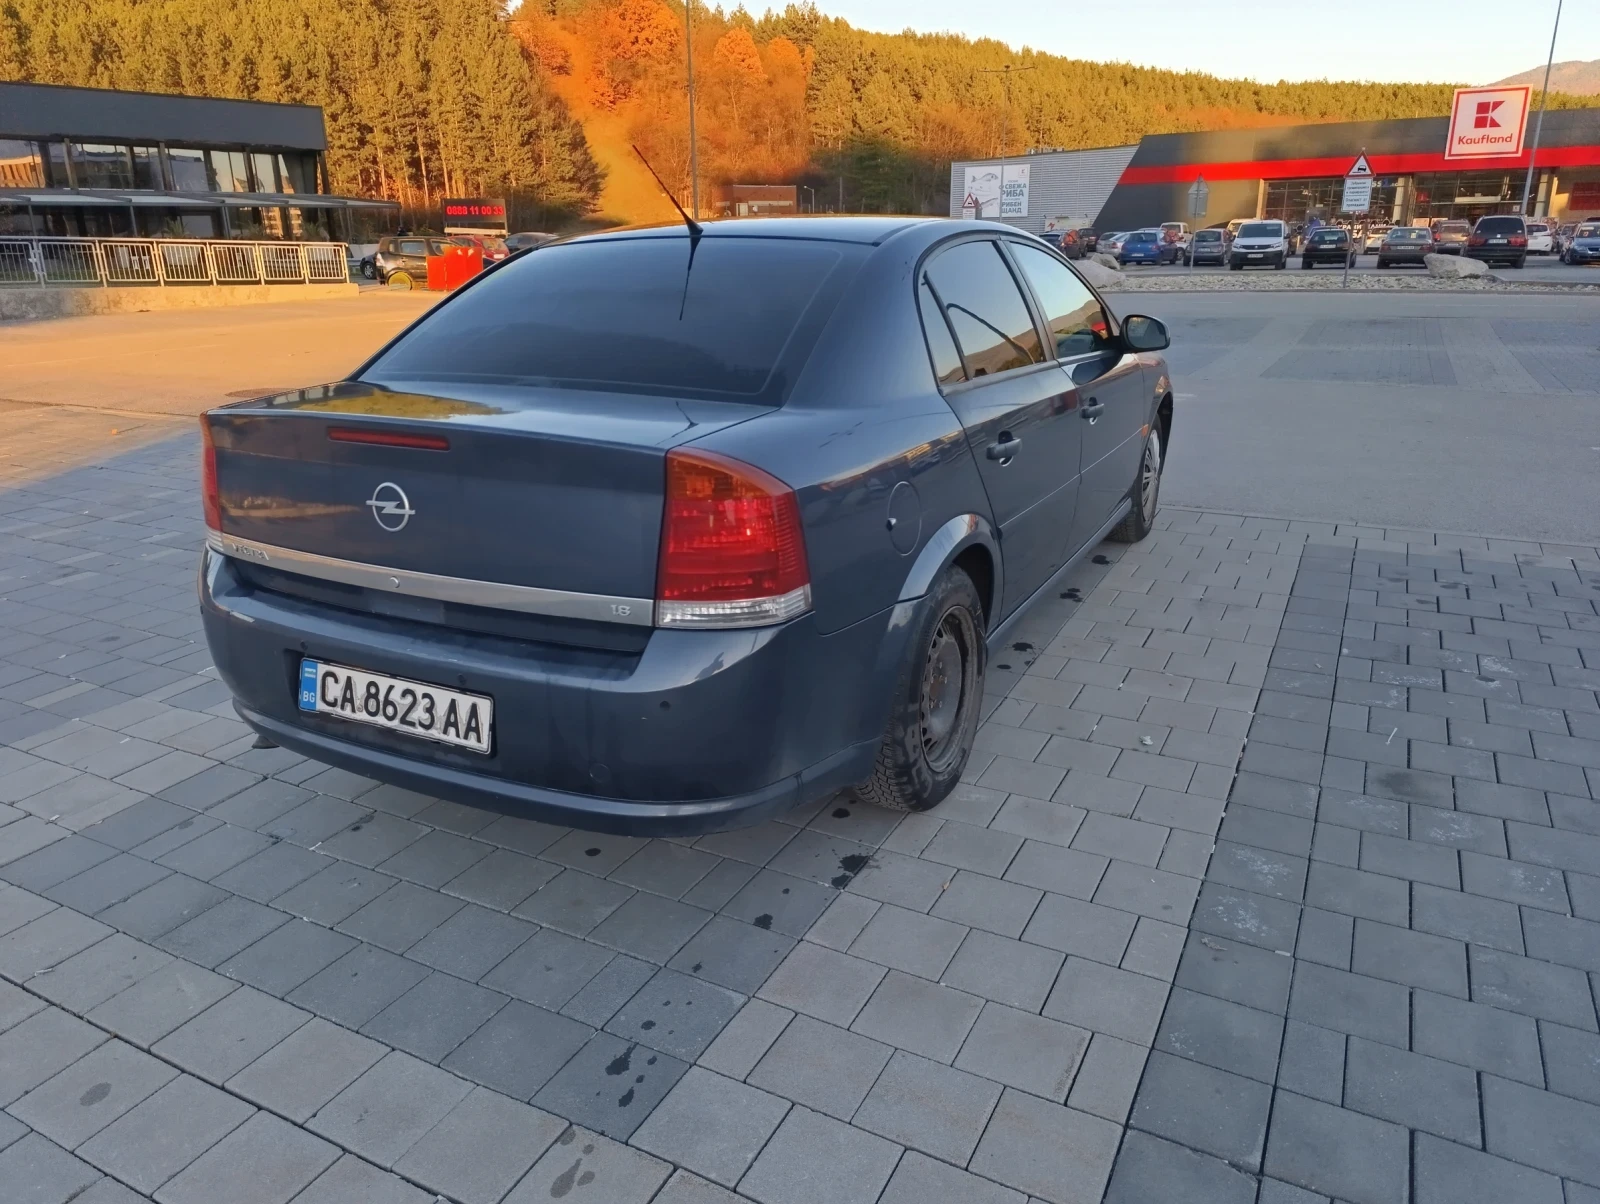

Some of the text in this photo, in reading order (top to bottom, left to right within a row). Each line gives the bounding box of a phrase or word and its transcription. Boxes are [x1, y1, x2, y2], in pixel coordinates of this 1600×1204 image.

[1458, 133, 1513, 145] Kaufland
[302, 692, 316, 702] BG
[320, 671, 484, 744] CA 8623 AA
